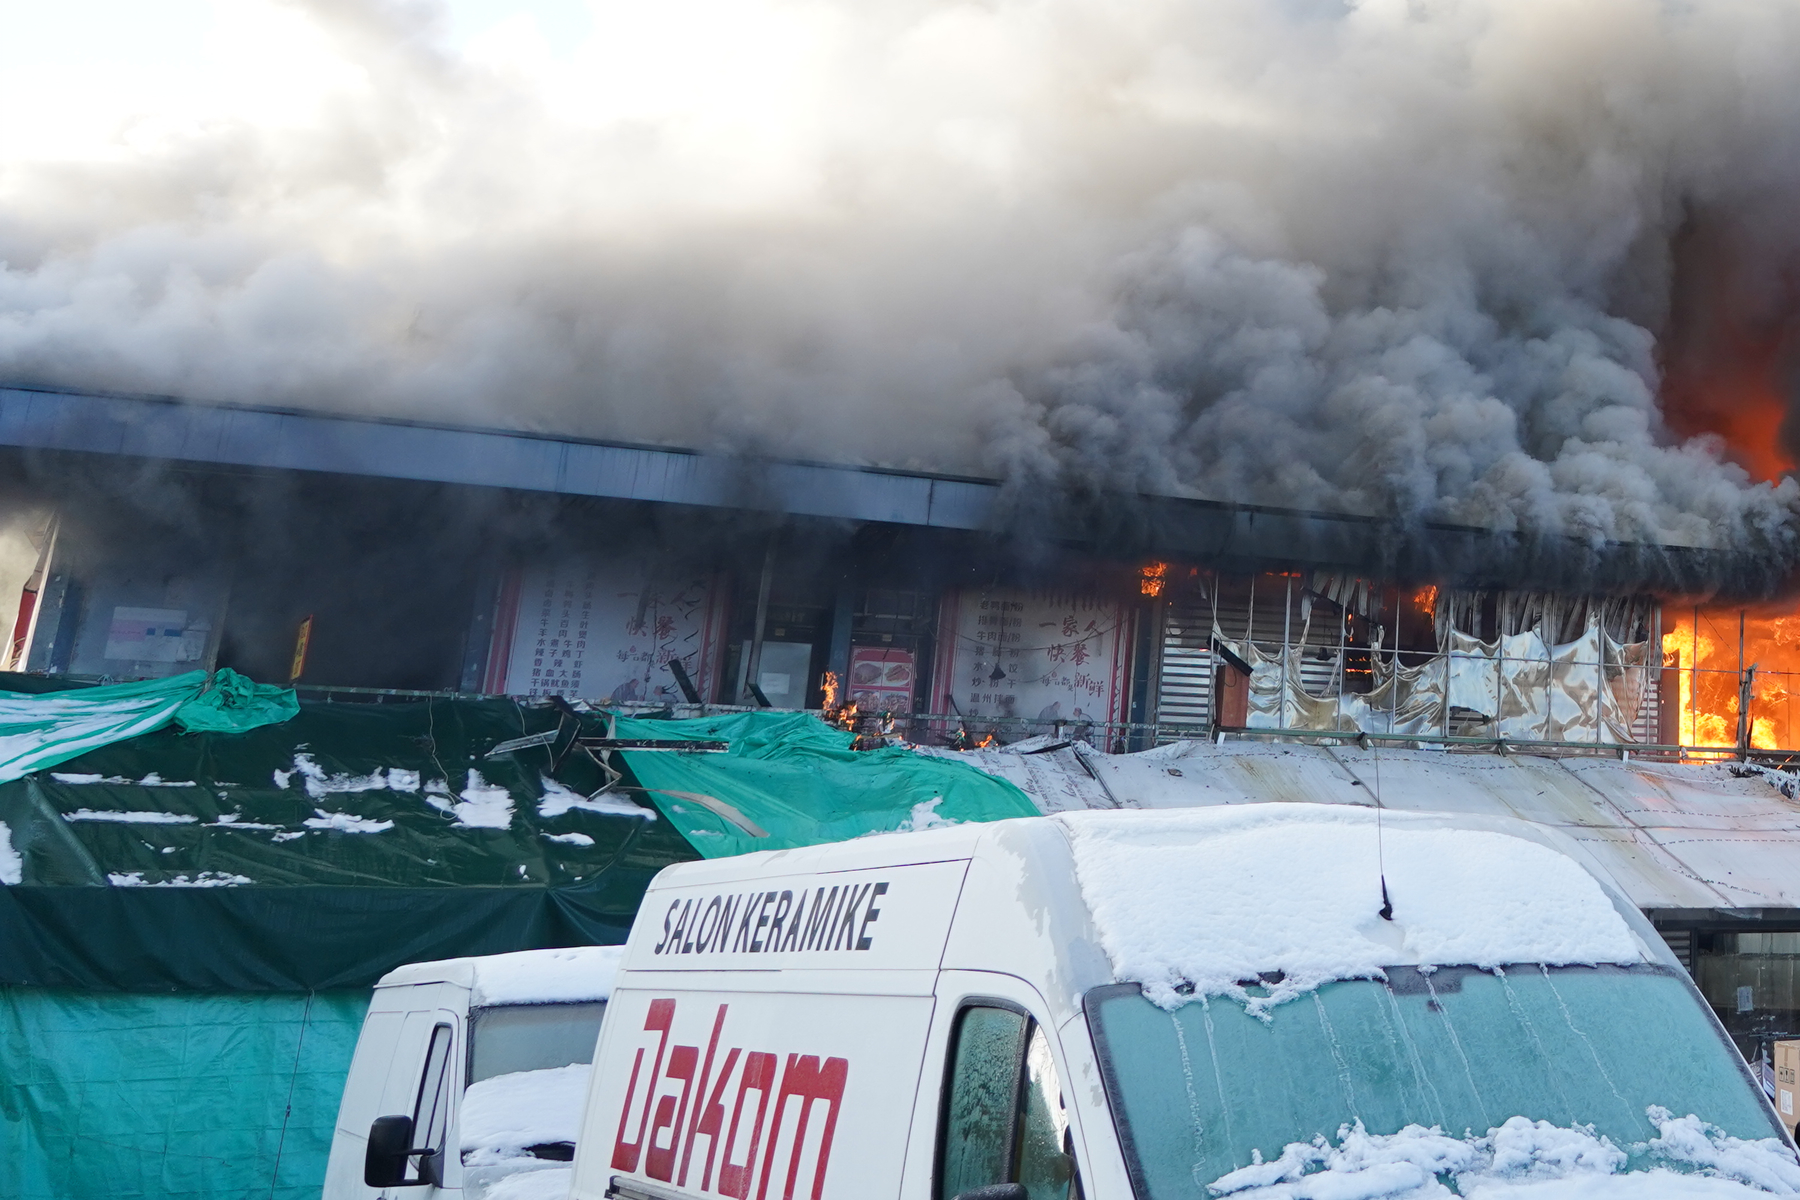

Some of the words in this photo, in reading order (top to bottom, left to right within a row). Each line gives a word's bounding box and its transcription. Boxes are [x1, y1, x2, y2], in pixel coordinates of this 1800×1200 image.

[1038, 615, 1104, 637] 一家人
[1047, 643, 1091, 666] 快餐
[654, 894, 742, 955] SALON
[732, 882, 890, 953] KERAMIKE
